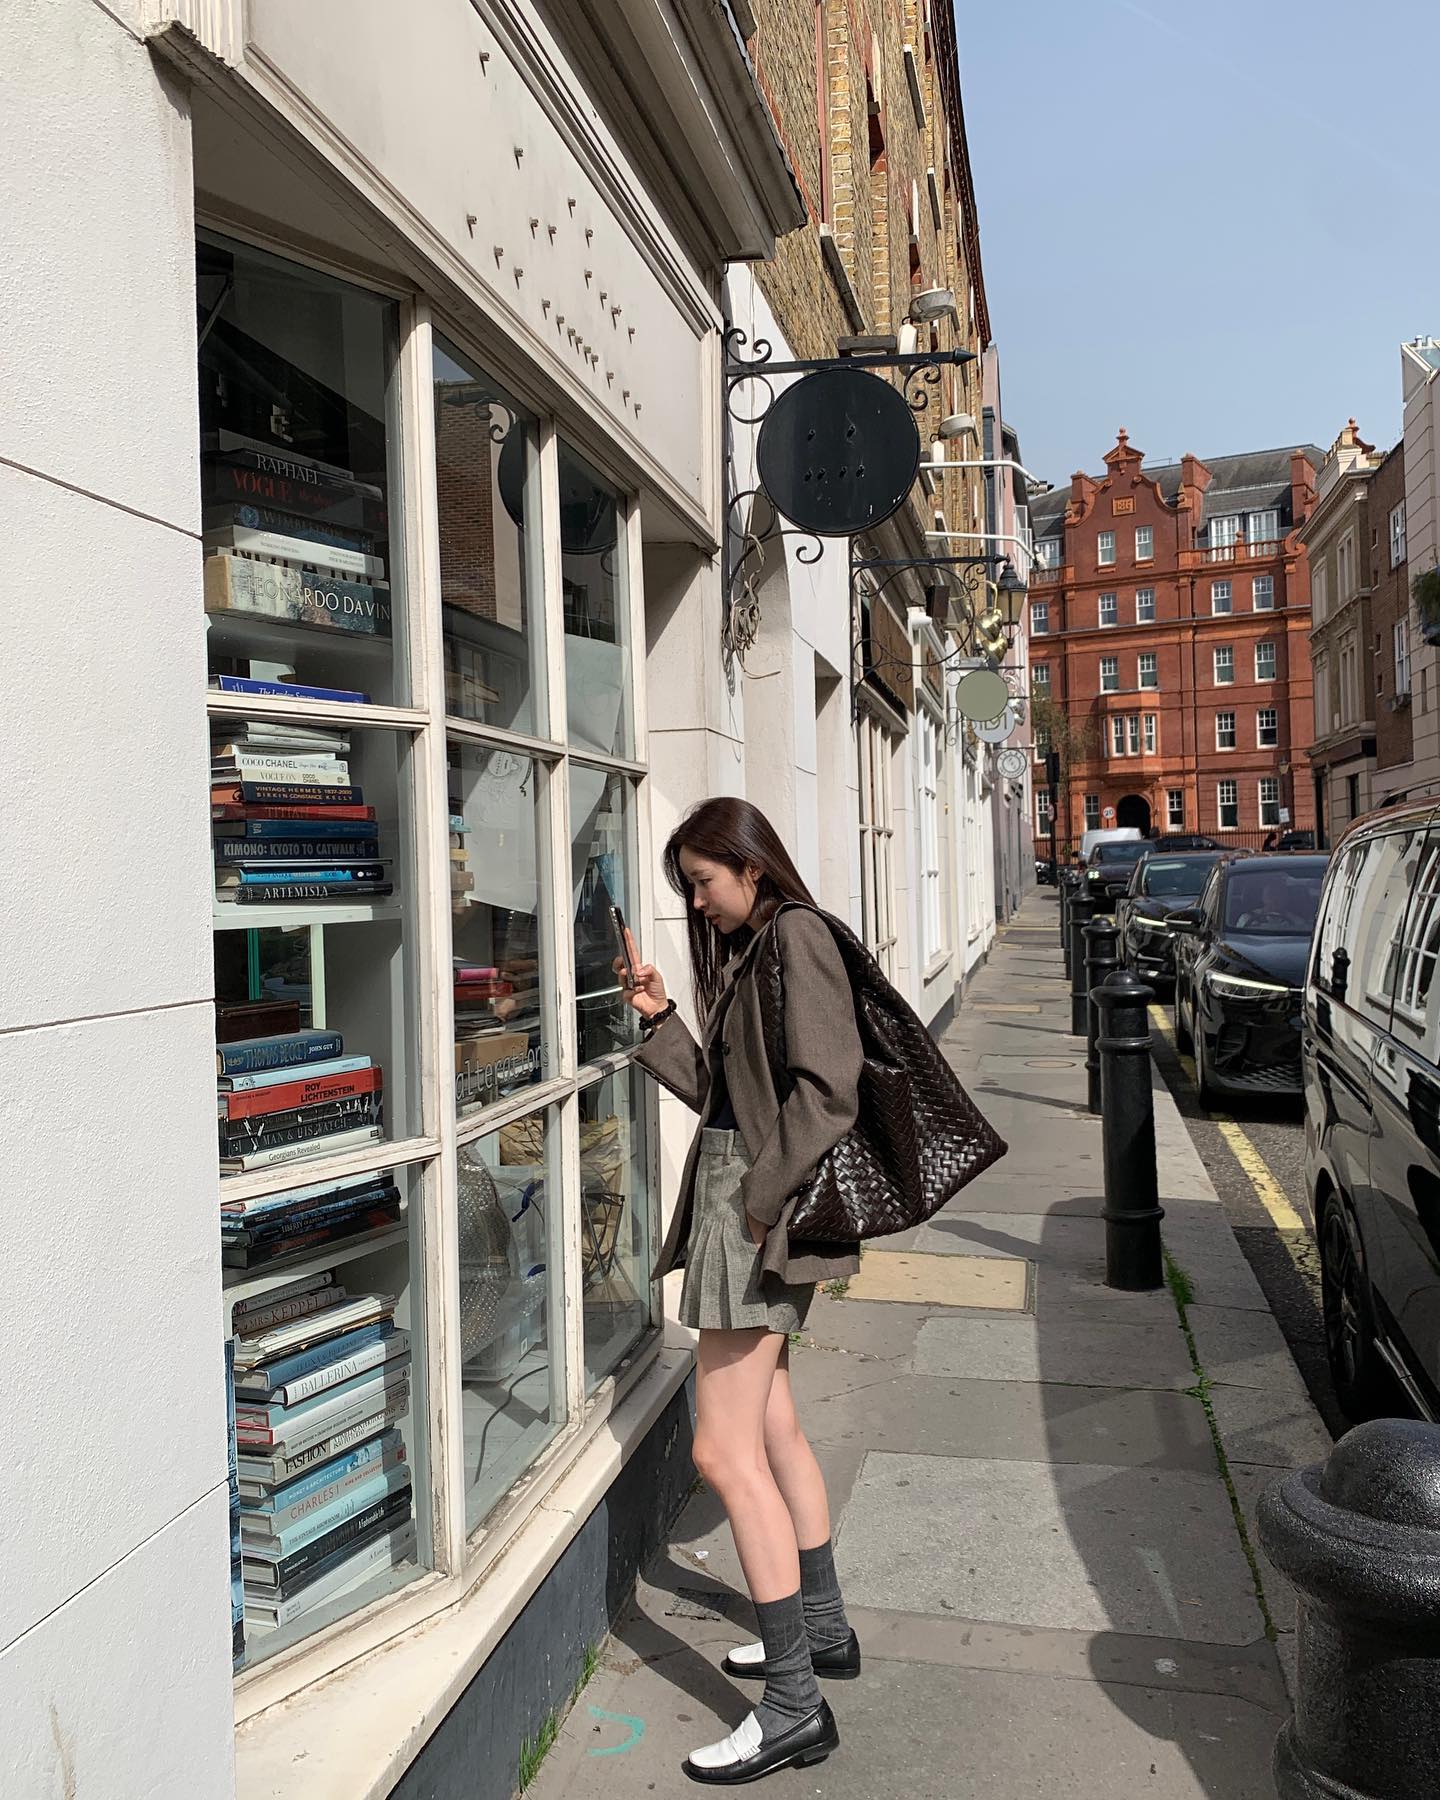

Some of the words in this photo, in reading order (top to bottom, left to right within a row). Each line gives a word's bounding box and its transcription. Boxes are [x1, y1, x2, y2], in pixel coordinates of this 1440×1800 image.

[256, 454, 322, 486] RAPHAEL
[231, 469, 292, 500] VOGUE
[247, 574, 339, 611] LEONARDO
[242, 757, 264, 766] COCO
[265, 758, 298, 769] CHANEL
[1103, 809, 1113, 817] 20
[223, 843, 268, 856] KIMONO:
[270, 843, 301, 856] KYOTO
[302, 843, 313, 855] TO
[316, 842, 355, 856] CATWALK
[263, 885, 328, 900] ARTEMISIA
[308, 1045, 323, 1055] JOHN
[323, 1043, 334, 1051] GUY
[456, 1042, 549, 1100] alterations
[300, 1085, 355, 1102] LICHTENSTEIN
[304, 1082, 321, 1092] ROY
[263, 1132, 284, 1145] MAN
[287, 1132, 296, 1140] &
[268, 1149, 296, 1162] Georgians
[296, 1142, 321, 1156] Revealed
[250, 1315, 269, 1328] MRS
[271, 1297, 320, 1323] KEPPEL
[300, 1360, 358, 1396] BALLERINA
[285, 1442, 328, 1474] FASHION
[289, 1487, 334, 1520] CHARLES
